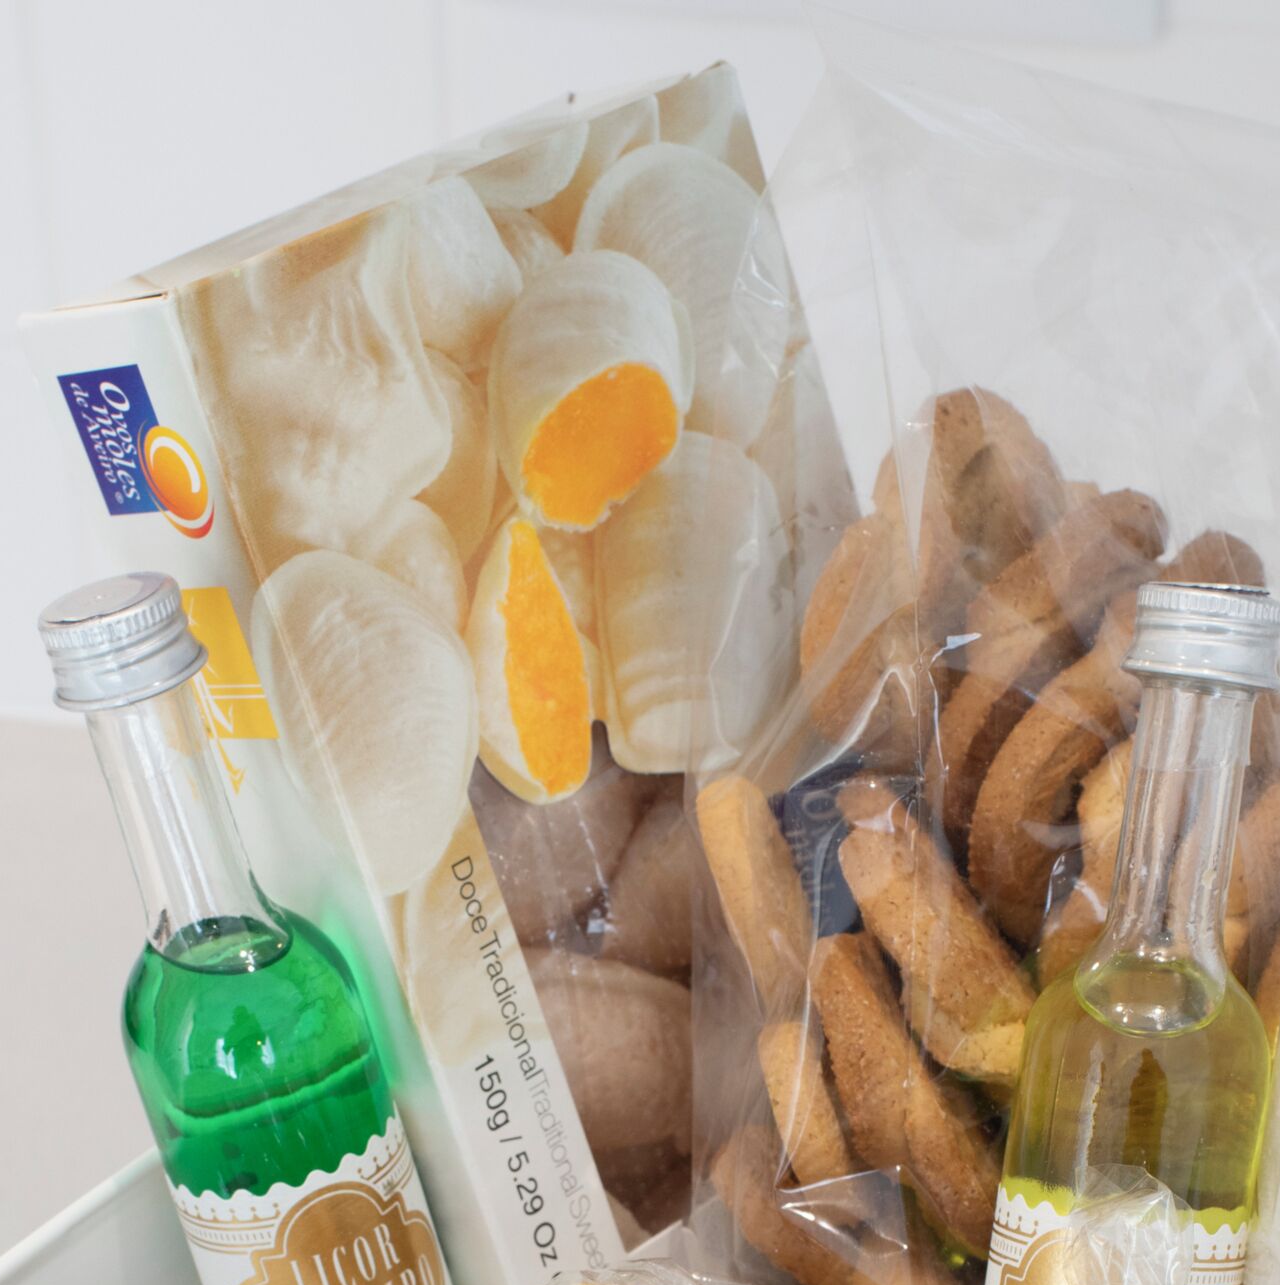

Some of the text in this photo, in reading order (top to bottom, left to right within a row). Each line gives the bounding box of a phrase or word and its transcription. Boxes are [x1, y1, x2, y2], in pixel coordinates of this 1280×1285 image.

[70, 382, 117, 485] de Aveiro
[92, 404, 141, 501] moles
[99, 381, 138, 455] Ovos
[451, 856, 609, 1270] Doce Tradicional Traditional Swee
[473, 1054, 511, 1133] 150g
[507, 1150, 545, 1216] 5.29
